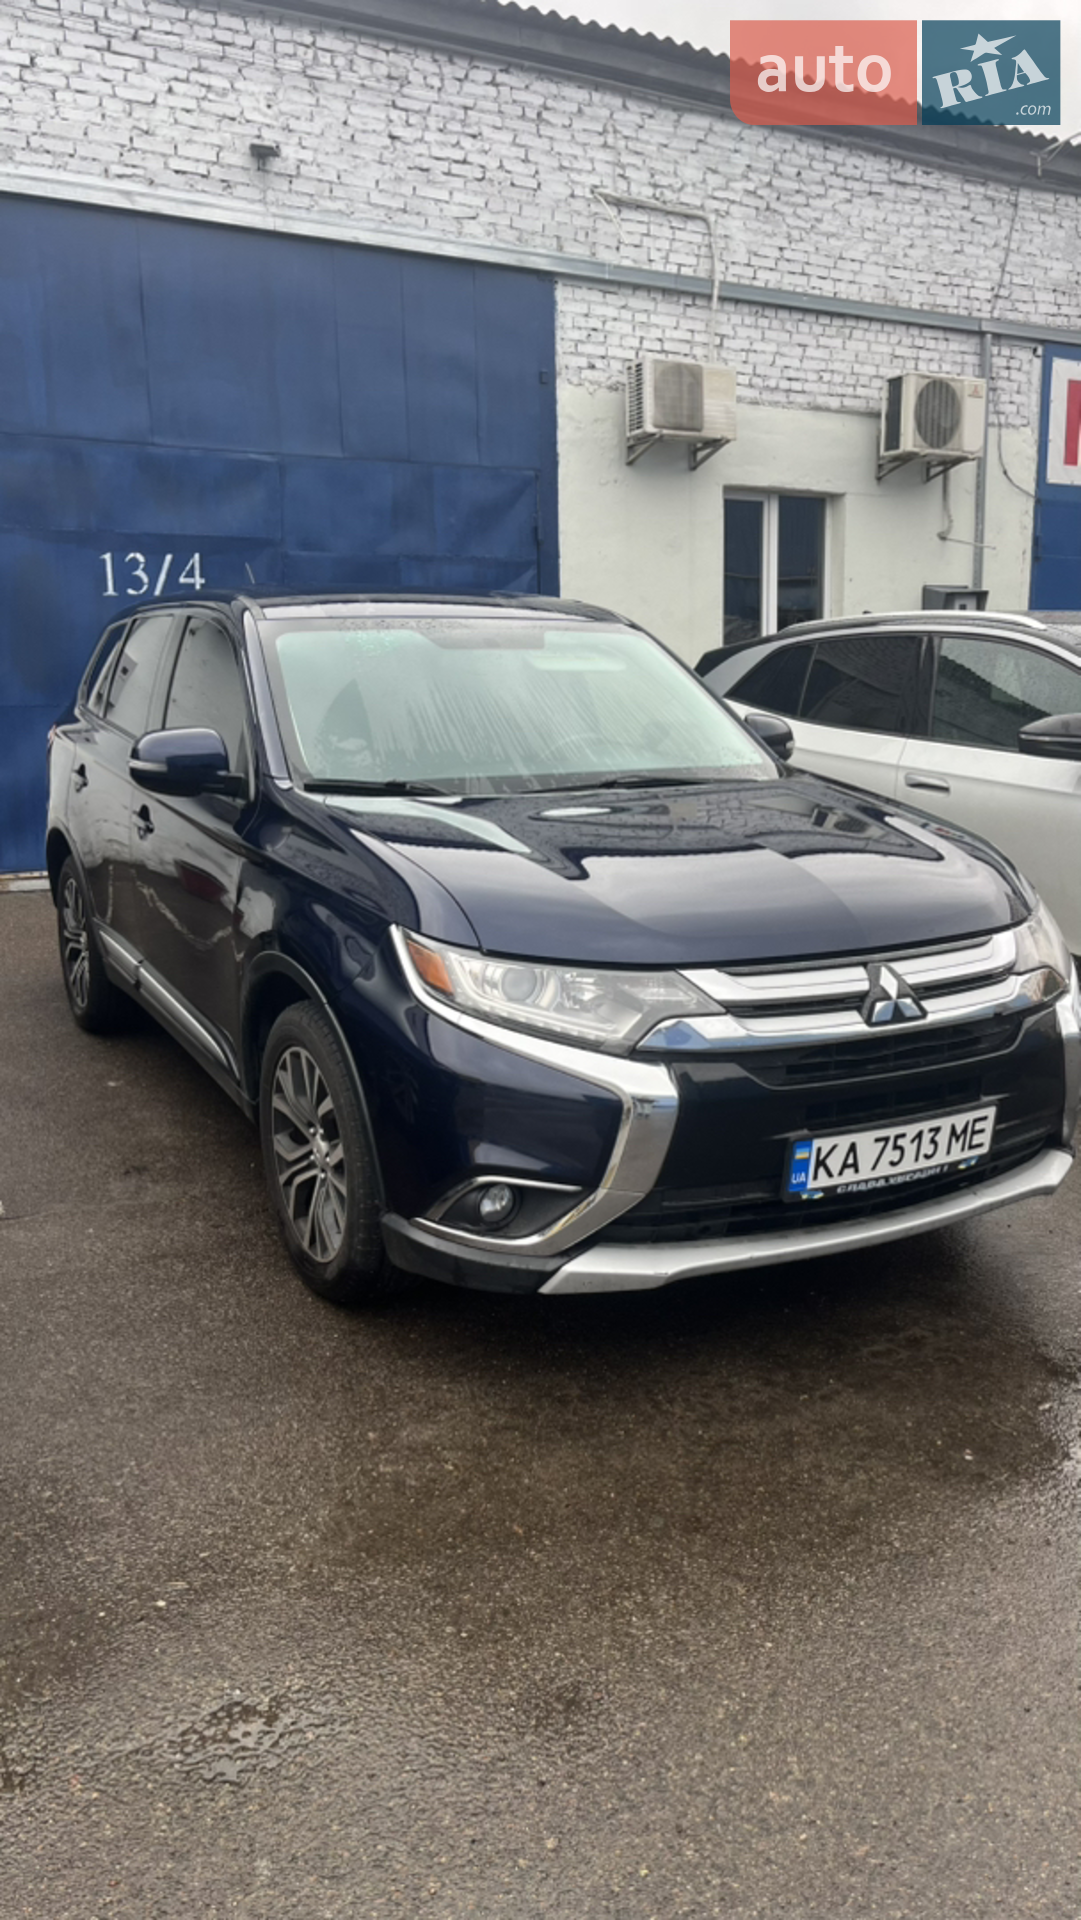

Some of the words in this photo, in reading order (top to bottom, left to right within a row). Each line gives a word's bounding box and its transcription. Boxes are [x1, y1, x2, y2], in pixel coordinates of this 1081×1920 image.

[99, 552, 206, 596] 13/4
[812, 1141, 860, 1181] KA
[871, 1126, 942, 1171] 7513
[946, 1115, 989, 1156] ME
[790, 1171, 807, 1185] UA
